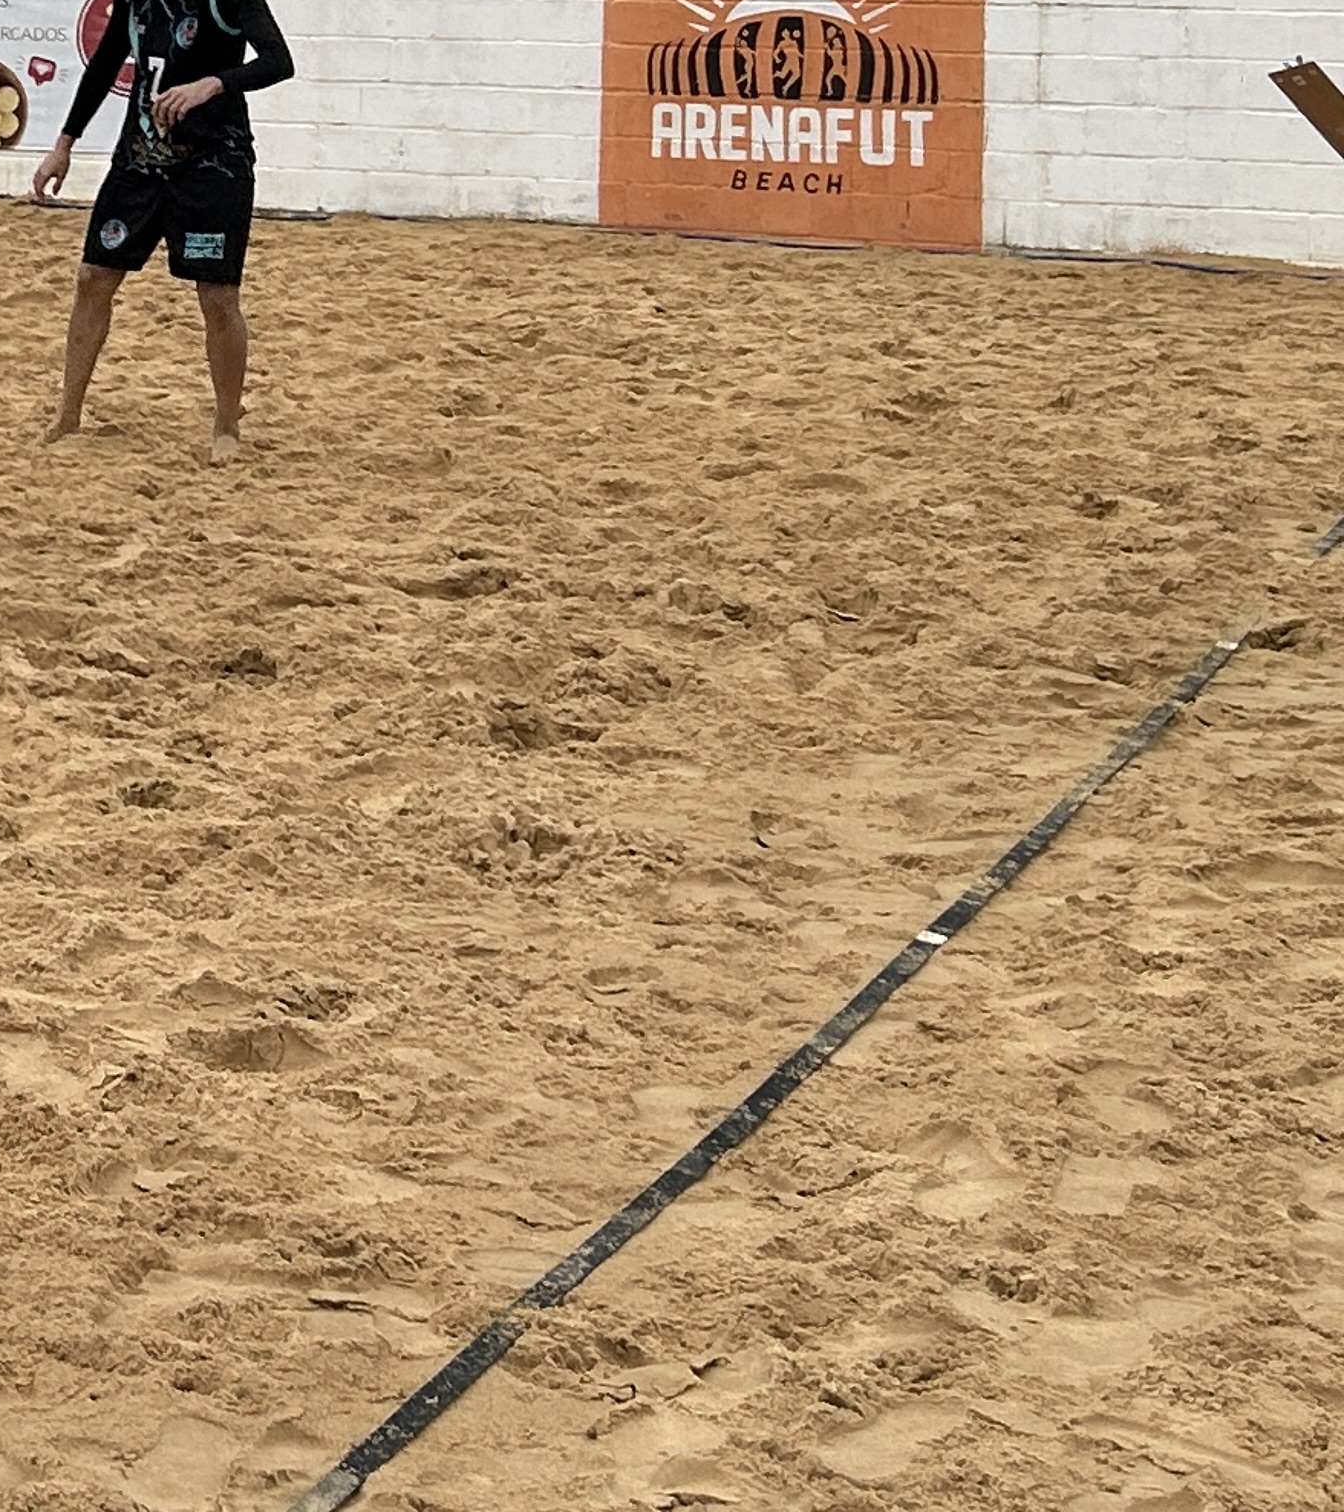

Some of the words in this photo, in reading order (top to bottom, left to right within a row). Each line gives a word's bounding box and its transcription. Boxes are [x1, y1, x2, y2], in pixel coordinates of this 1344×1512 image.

[148, 56, 166, 103] 7
[650, 102, 933, 167] ARENAFUT
[730, 169, 844, 195] BEACH
